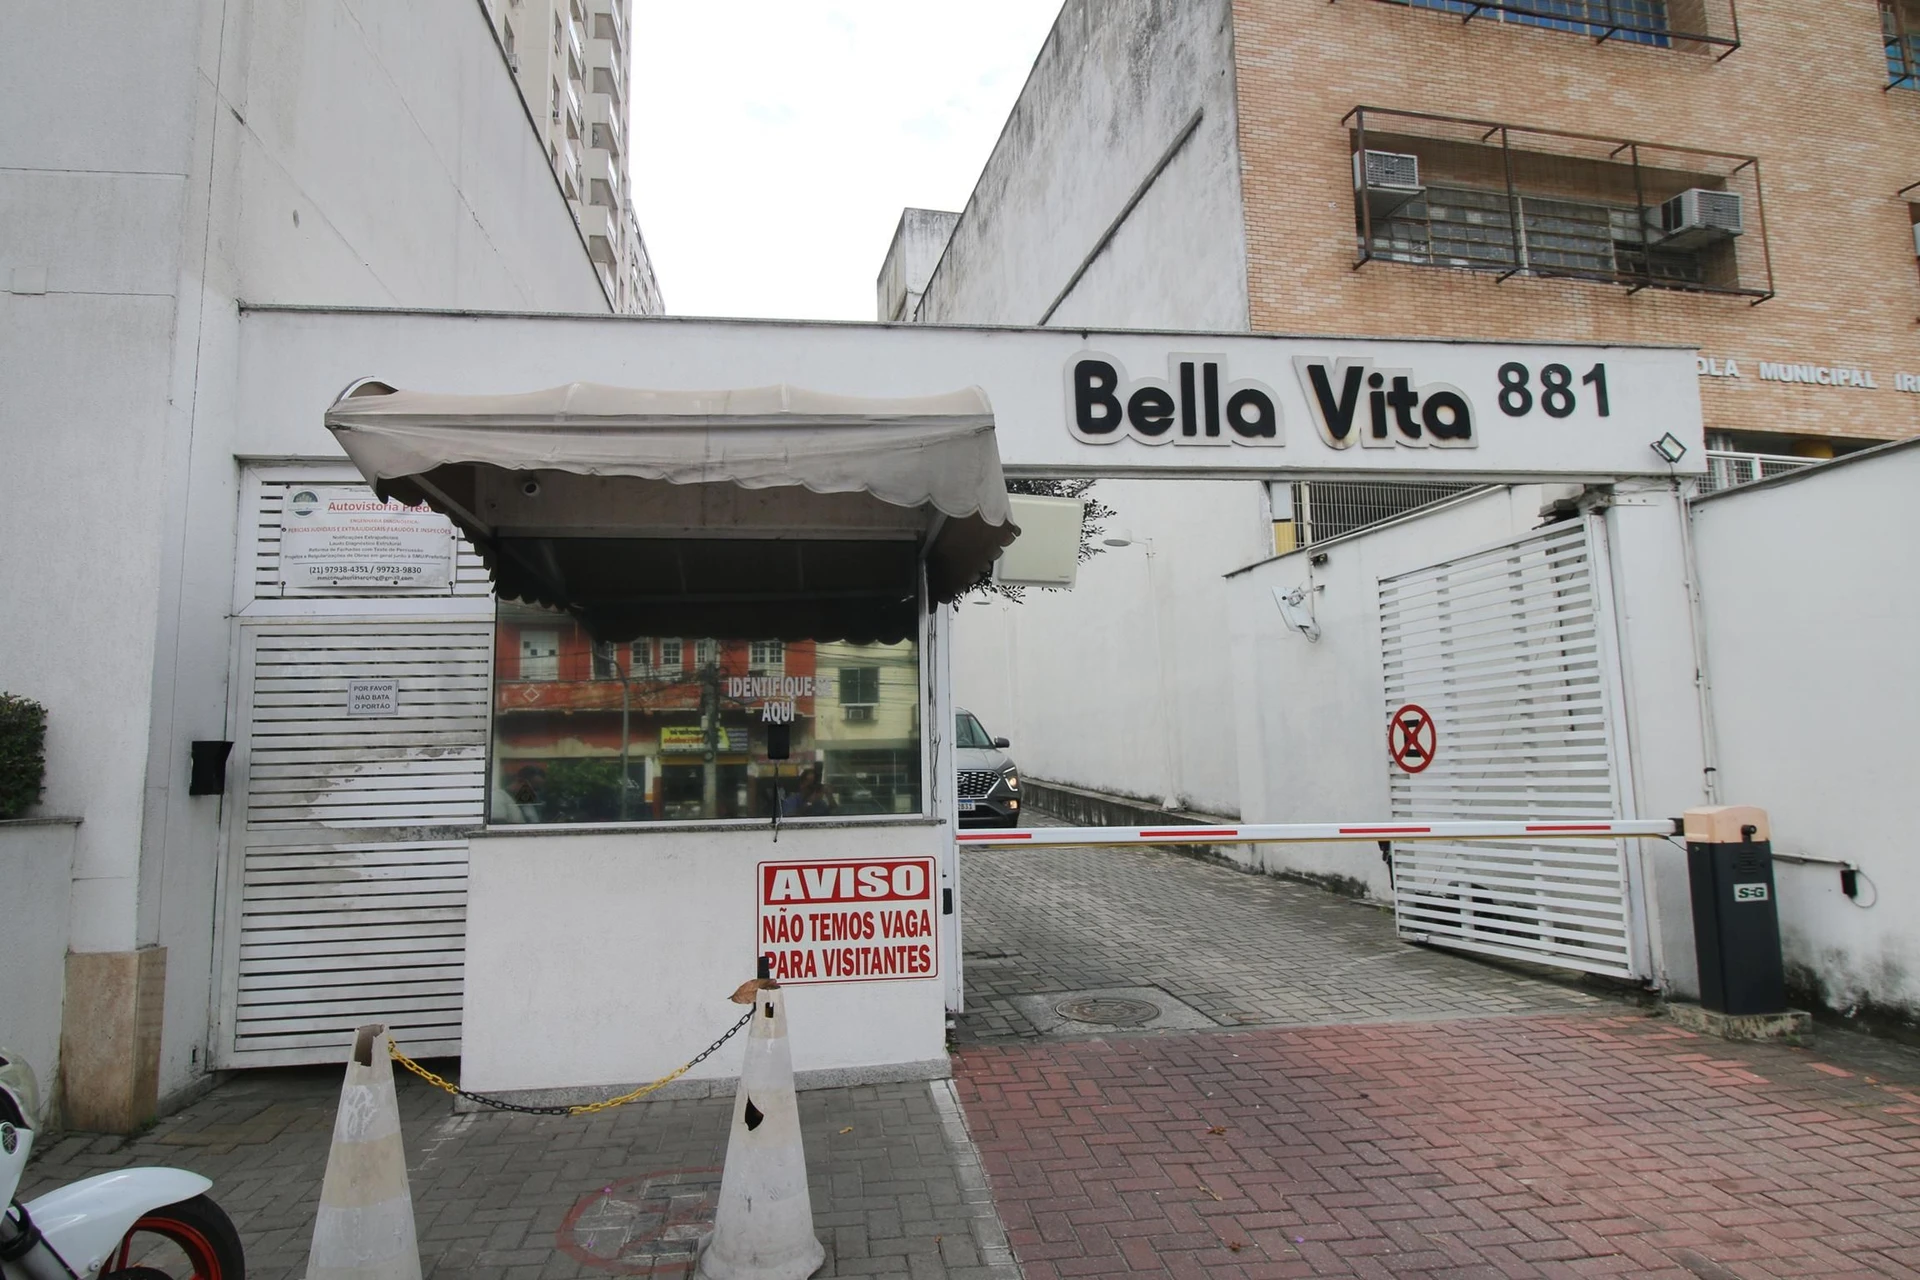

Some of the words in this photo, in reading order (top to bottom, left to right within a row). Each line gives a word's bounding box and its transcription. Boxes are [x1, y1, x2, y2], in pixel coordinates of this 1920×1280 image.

[1498, 362, 1609, 418] 881
[1759, 361, 1878, 389] MUNICIPAL
[1074, 359, 1276, 437] Bella
[1306, 363, 1471, 440] Vita
[328, 501, 398, 511] Autovistoria
[309, 566, 324, 575] (21)
[770, 865, 925, 901] AVISO
[763, 907, 804, 943] NÃO
[809, 911, 875, 942] TEMOS
[880, 909, 932, 938] VAGA
[764, 950, 817, 979] PARA
[822, 944, 931, 977] VISITANTES
